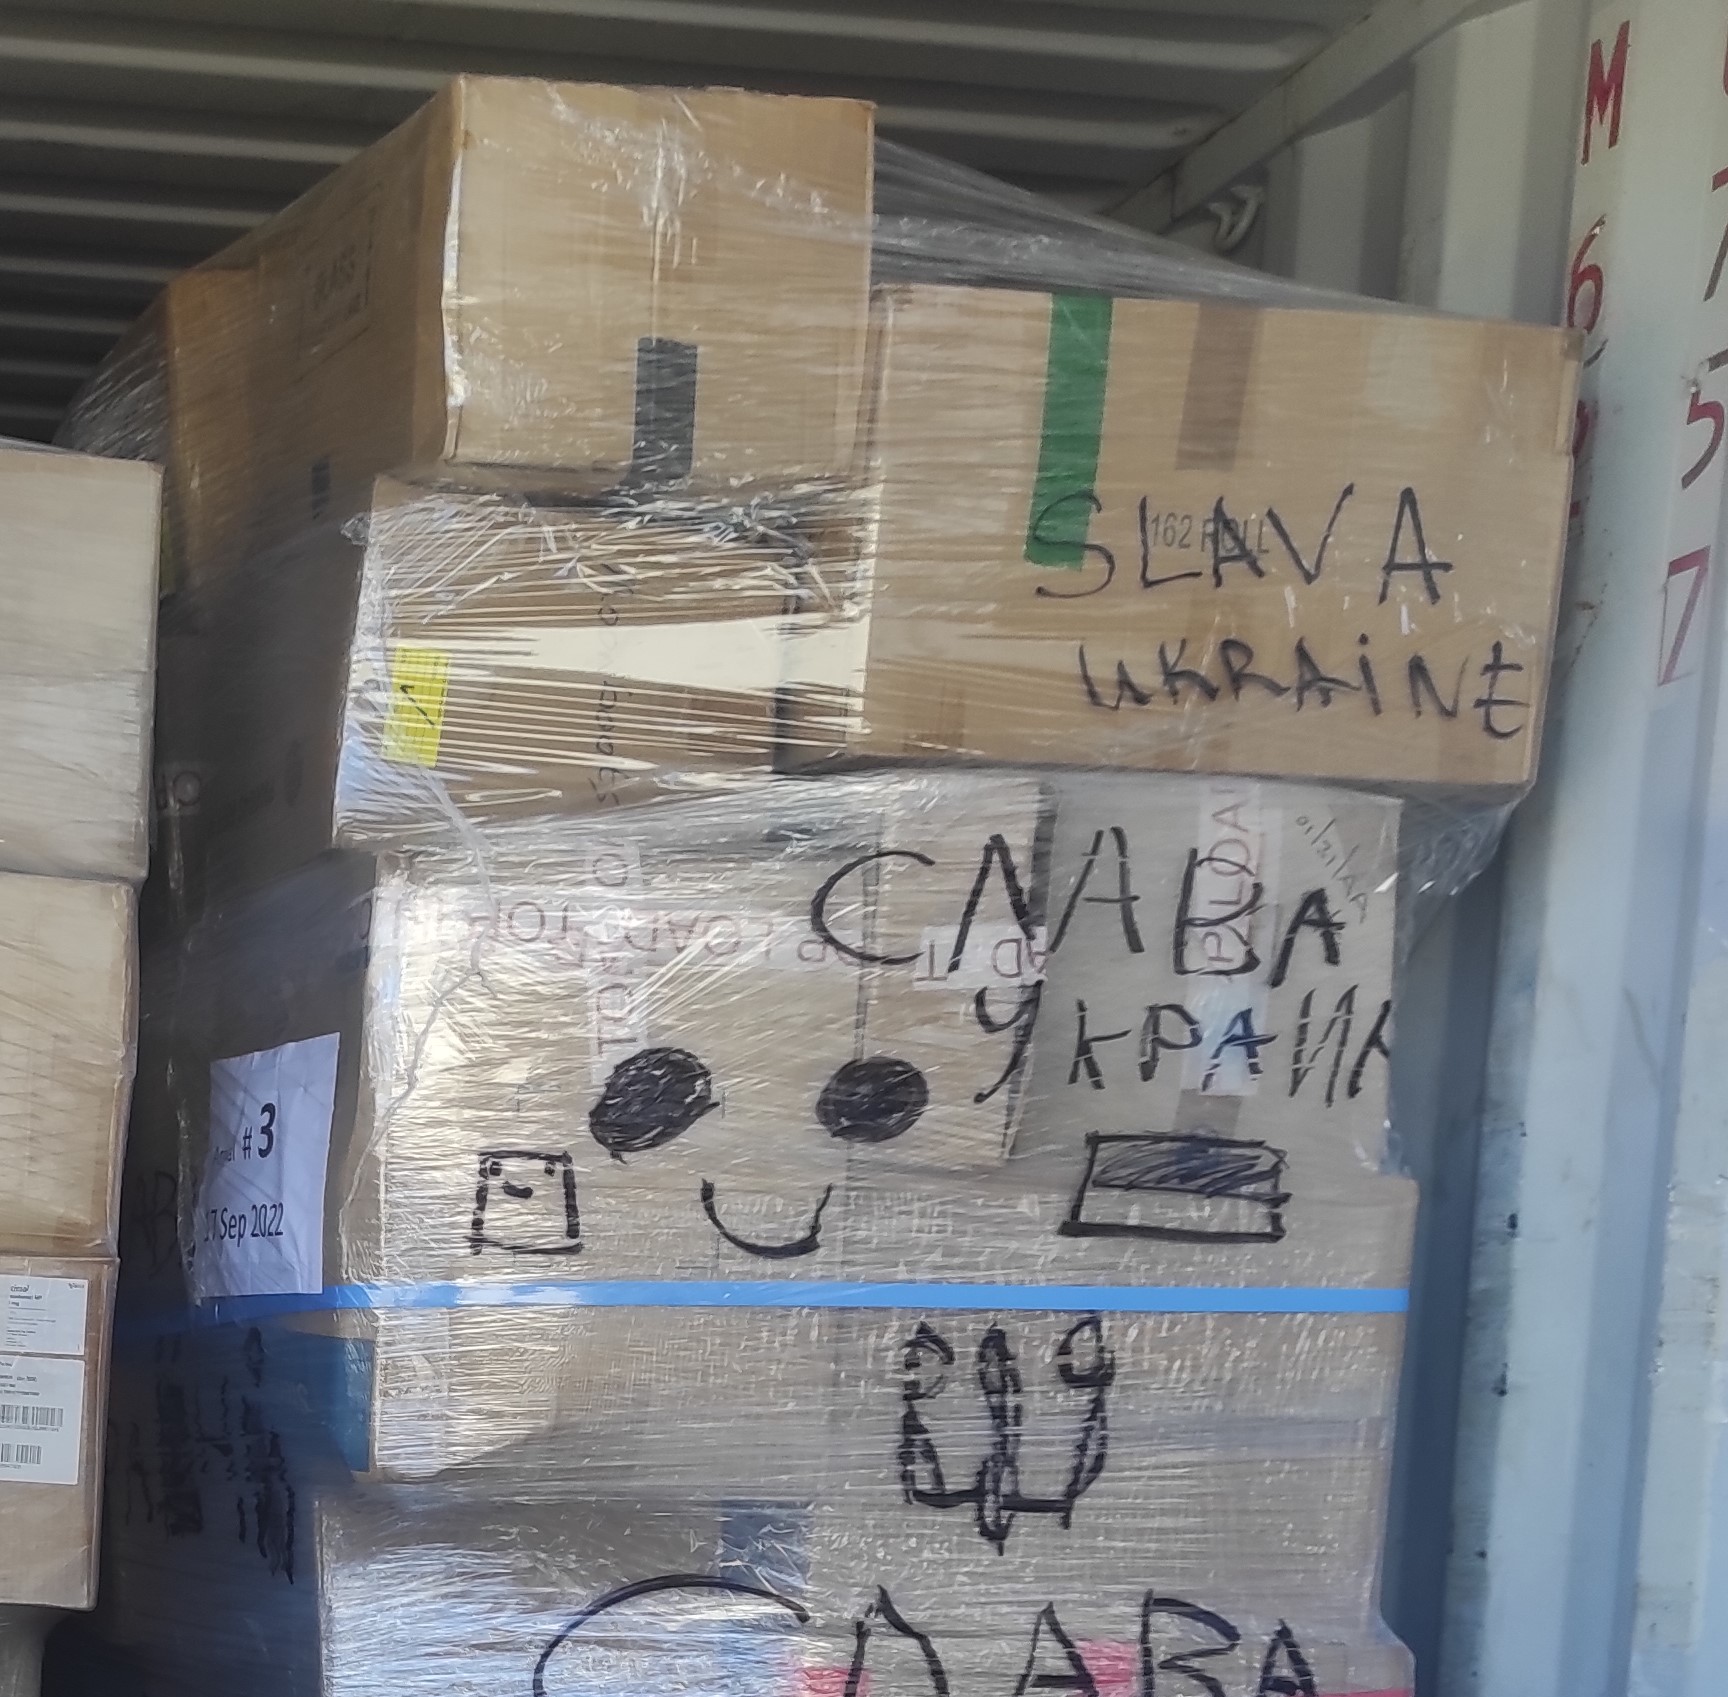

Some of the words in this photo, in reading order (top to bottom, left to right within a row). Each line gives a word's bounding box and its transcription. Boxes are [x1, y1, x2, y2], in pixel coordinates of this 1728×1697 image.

[1028, 483, 1454, 605] SLAVA
[810, 825, 1346, 988] СЛАВА
[257, 1102, 277, 1159] 3
[221, 1206, 248, 1248] Sep
[250, 1201, 285, 1239] 2022
